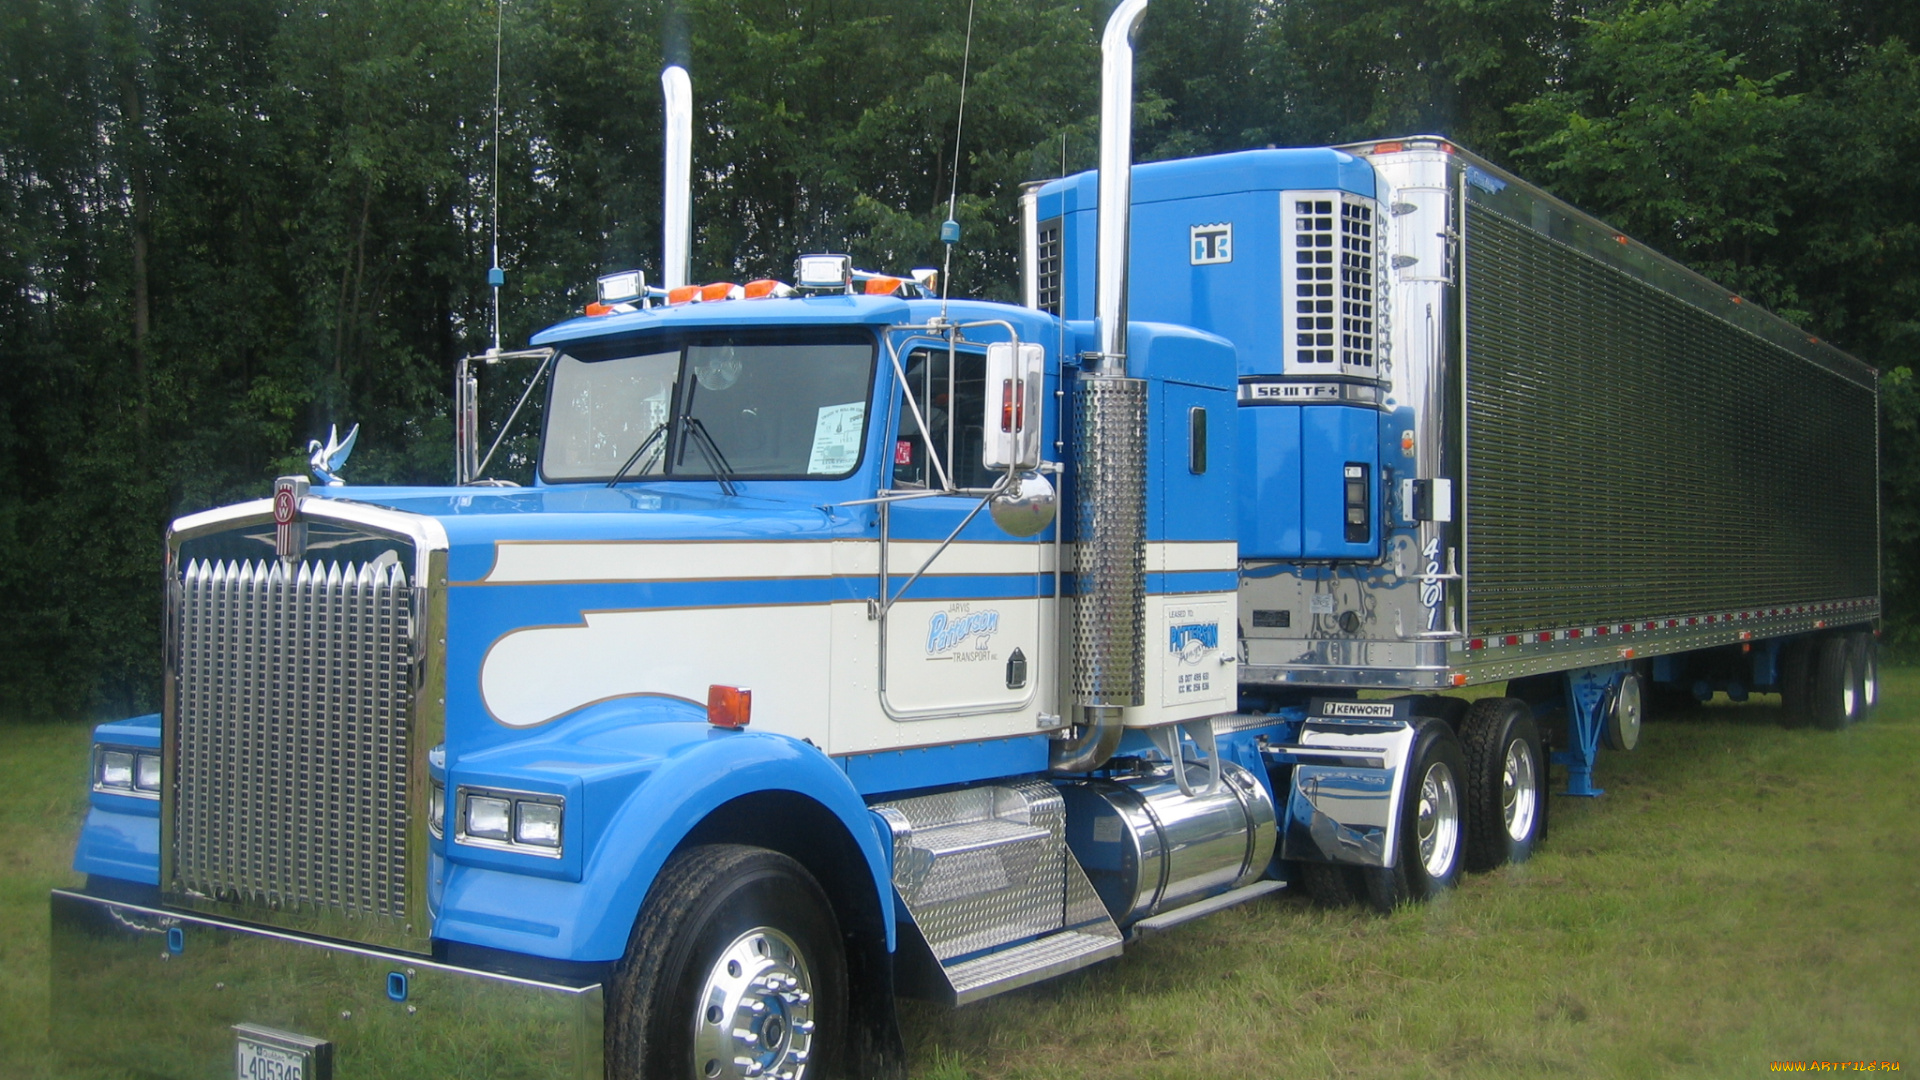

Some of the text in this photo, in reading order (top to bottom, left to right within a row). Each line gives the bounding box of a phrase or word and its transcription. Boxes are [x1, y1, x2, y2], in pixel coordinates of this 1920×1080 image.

[948, 603, 970, 613] JARVIS
[1168, 610, 1186, 618] LEASED
[1169, 622, 1218, 652] PATTERSON
[952, 651, 990, 662] TRANSPORT
[1185, 674, 1193, 682] DOT
[1336, 704, 1391, 715] KENWORTH
